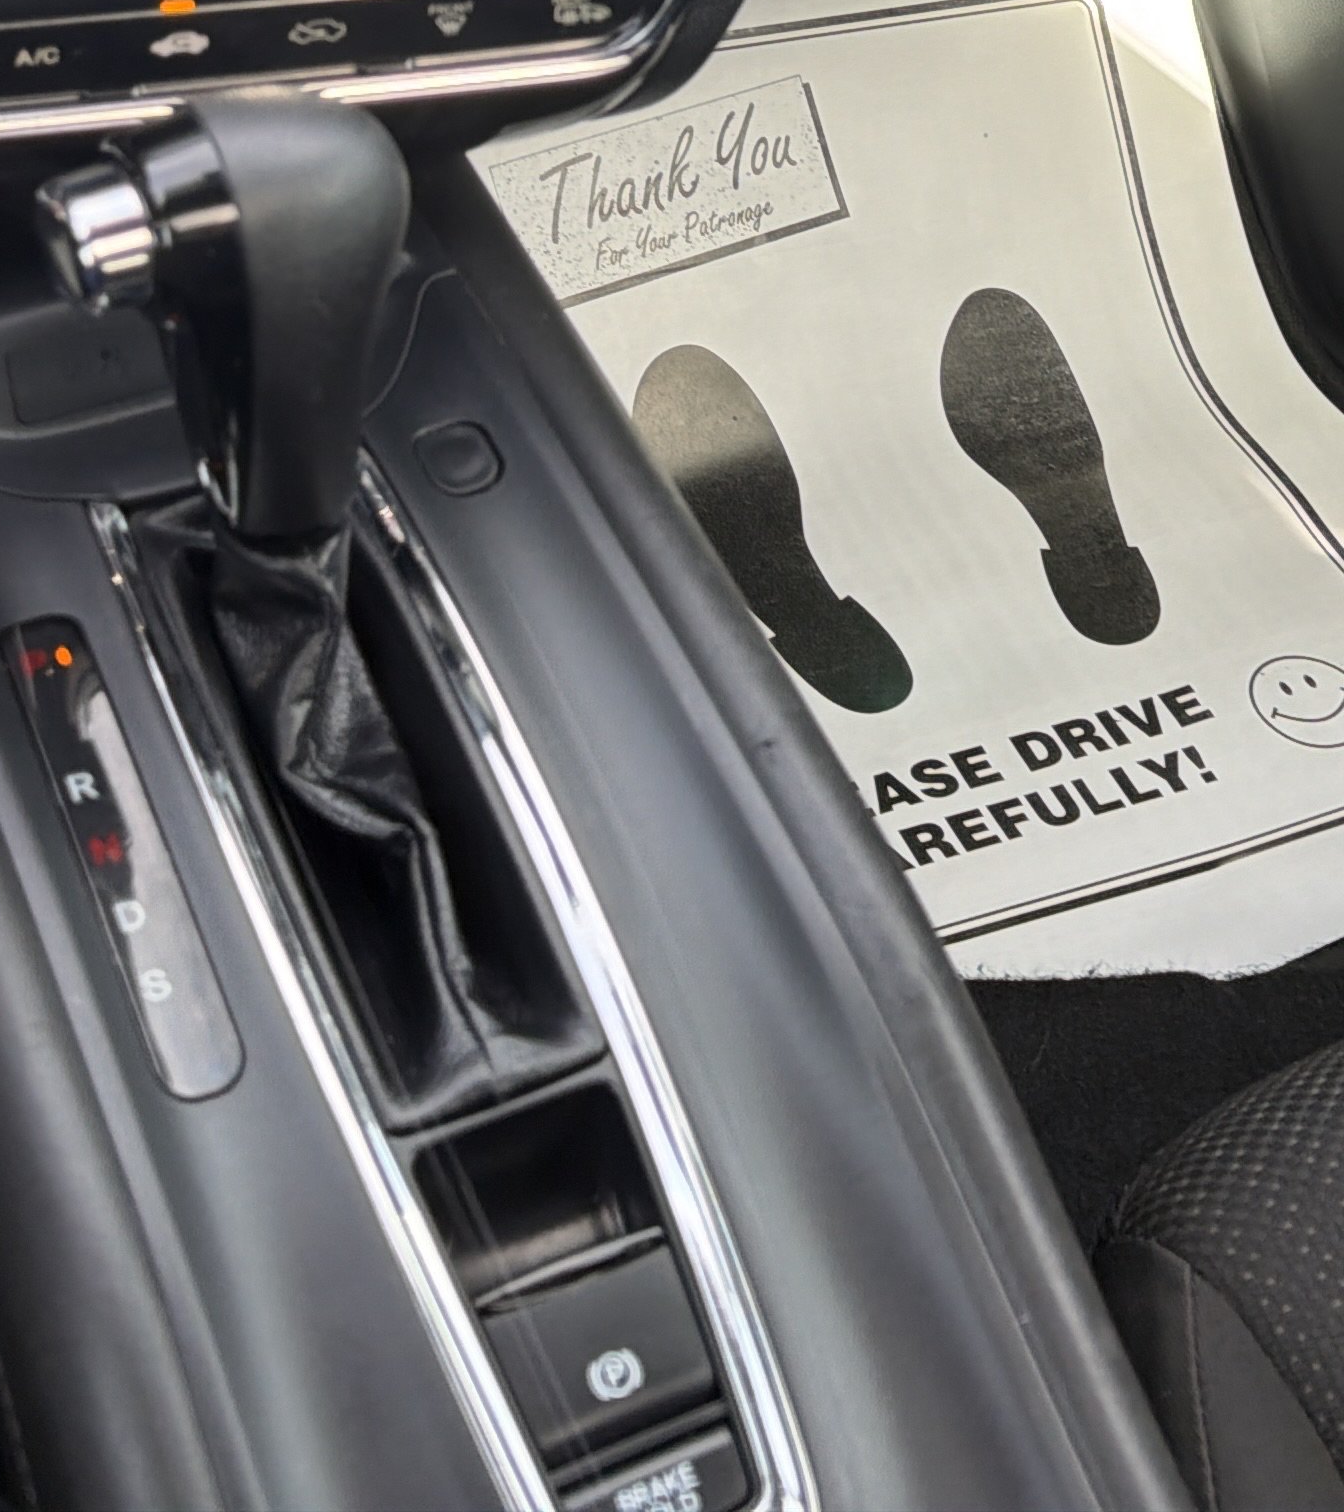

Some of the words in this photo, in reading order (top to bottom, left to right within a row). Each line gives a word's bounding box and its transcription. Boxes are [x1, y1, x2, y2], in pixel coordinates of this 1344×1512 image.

[14, 46, 61, 68] A/C
[539, 124, 701, 244] Thank
[714, 102, 798, 190] You
[595, 238, 629, 271] For
[635, 224, 676, 259] Your
[684, 200, 774, 244] Patronage
[859, 745, 1005, 819] ASE
[1009, 684, 1215, 773] DRIVE
[63, 770, 101, 806] R
[112, 898, 147, 935] D
